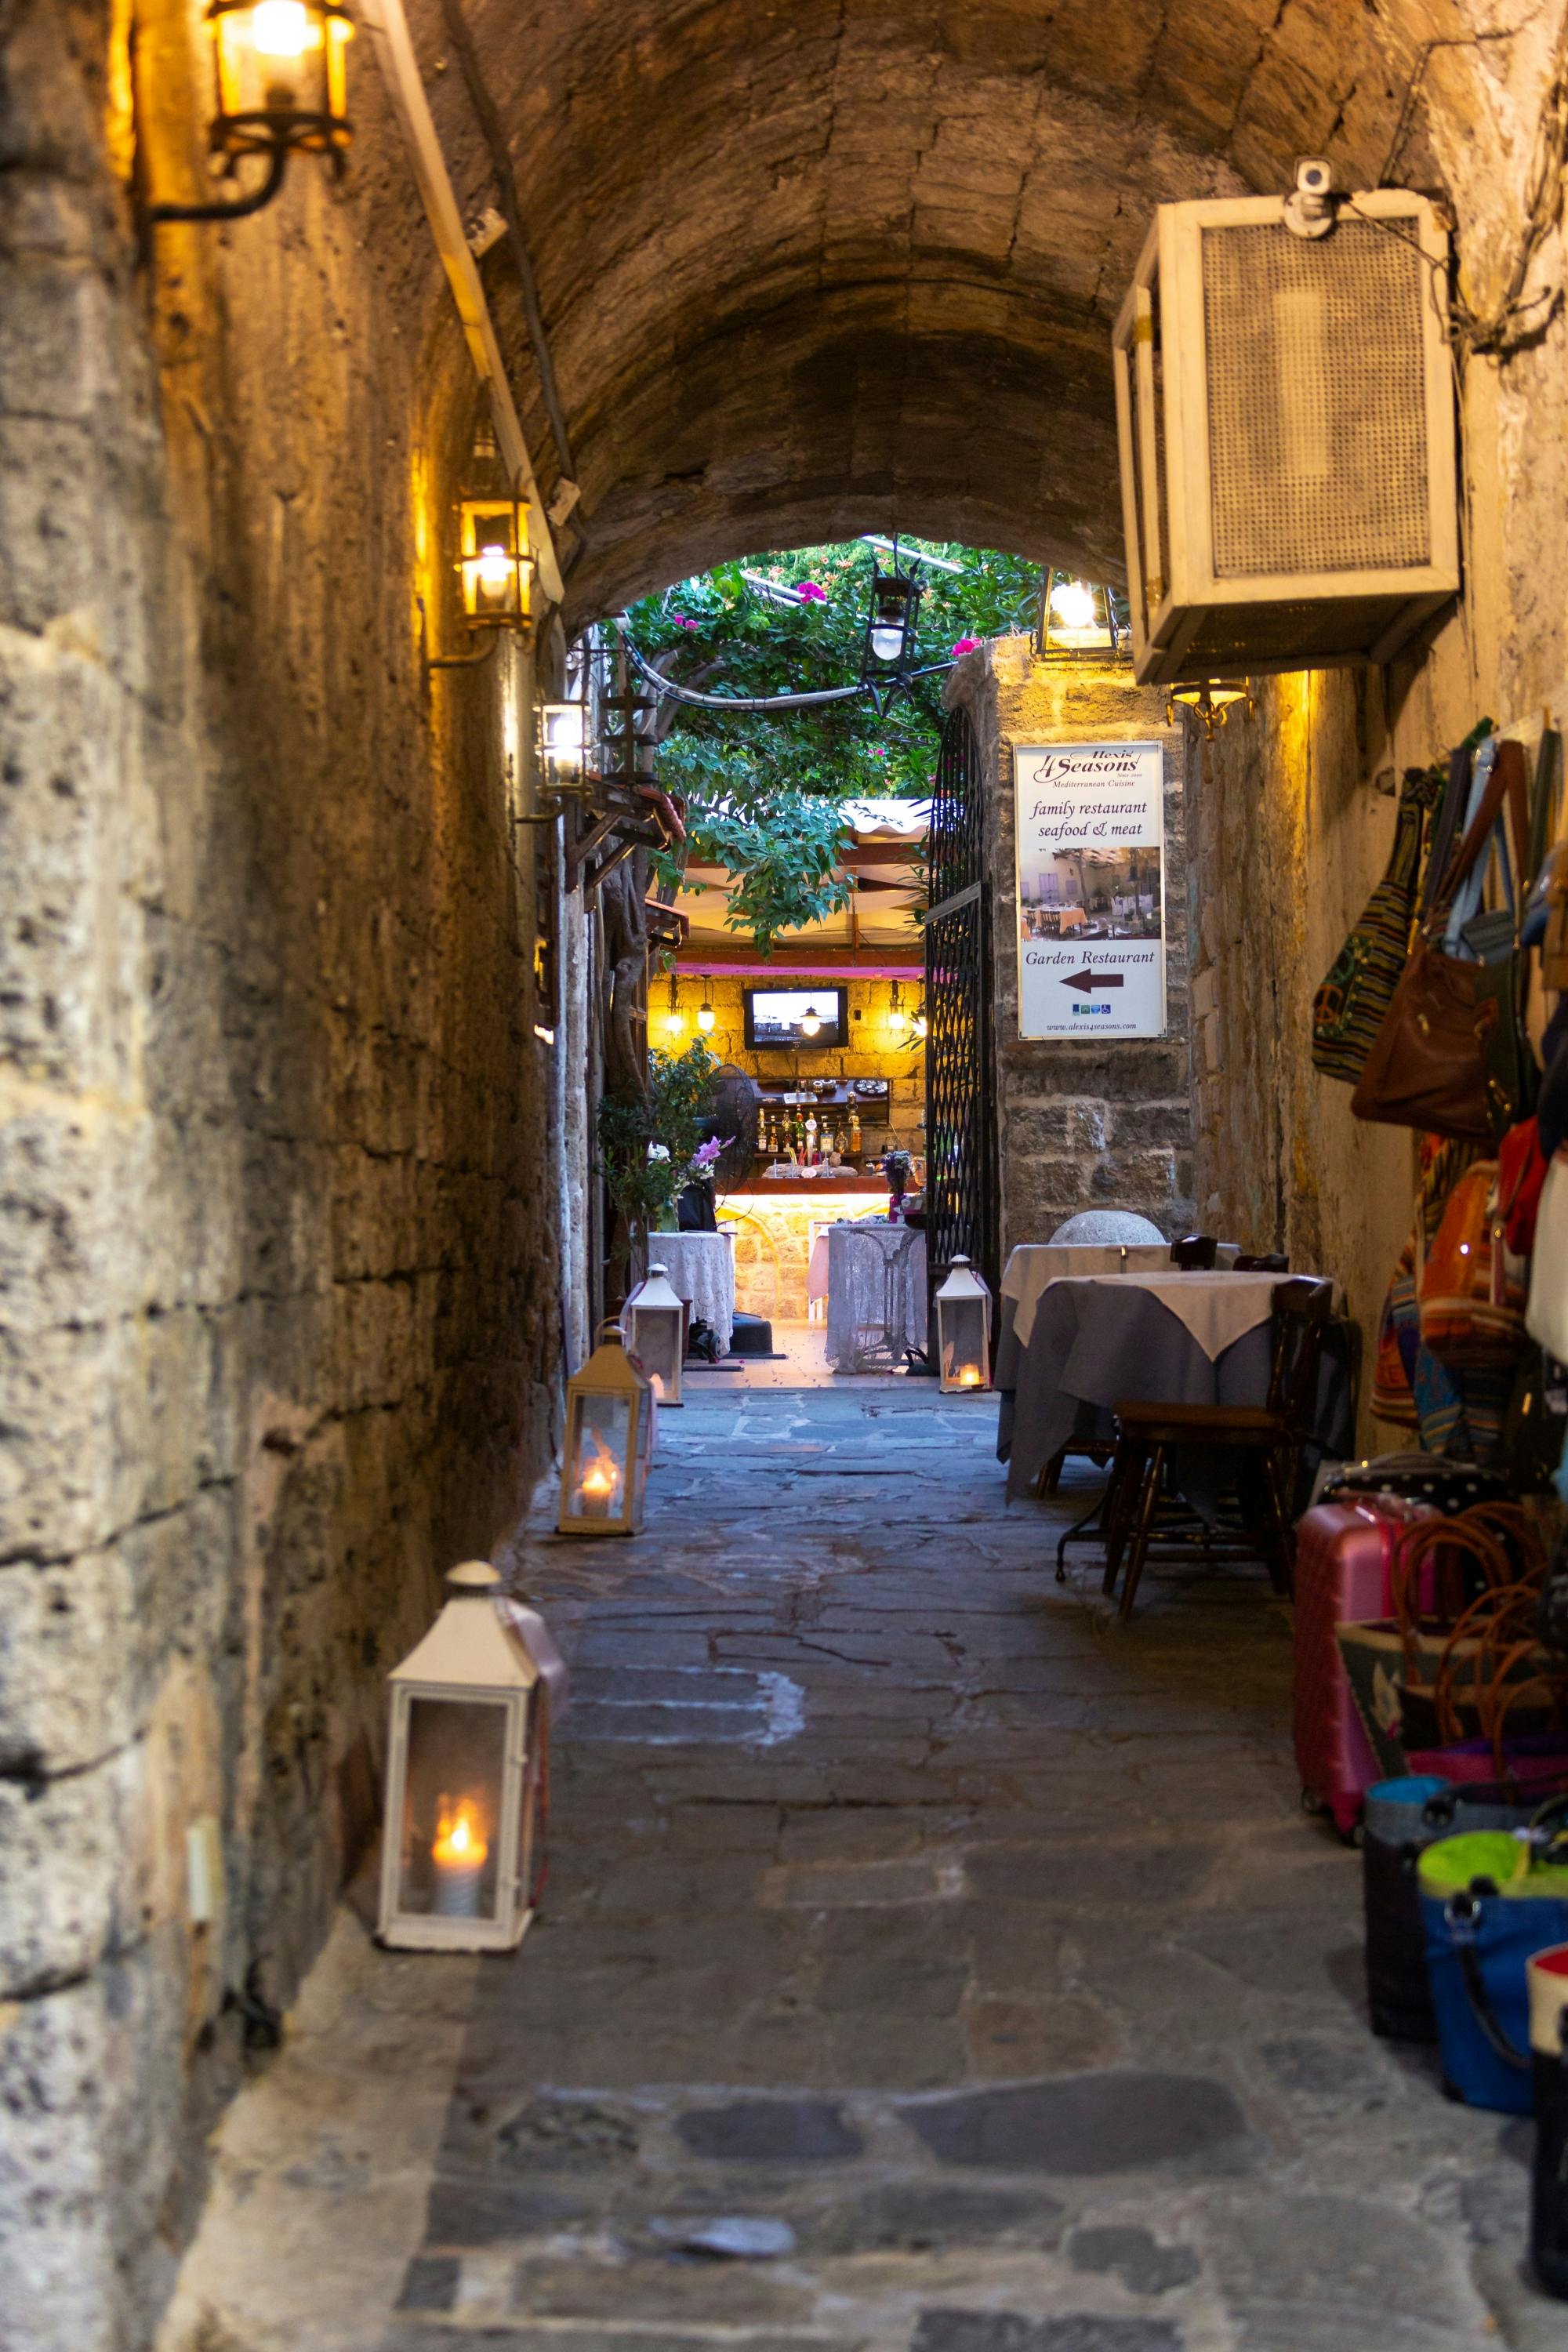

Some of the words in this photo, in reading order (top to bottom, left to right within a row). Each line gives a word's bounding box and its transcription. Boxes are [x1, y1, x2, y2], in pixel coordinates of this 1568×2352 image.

[1033, 755, 1057, 782] 4
[1058, 753, 1142, 773] Seasons
[1029, 800, 1075, 819] family
[1080, 802, 1147, 815] restaurant
[1038, 822, 1091, 840] seafood
[1093, 822, 1107, 837] &
[1111, 824, 1142, 835] meat
[1025, 952, 1075, 964] Garden
[1081, 951, 1155, 964] Restaurant
[1047, 1022, 1136, 1031] www.alexis4seasons.com
